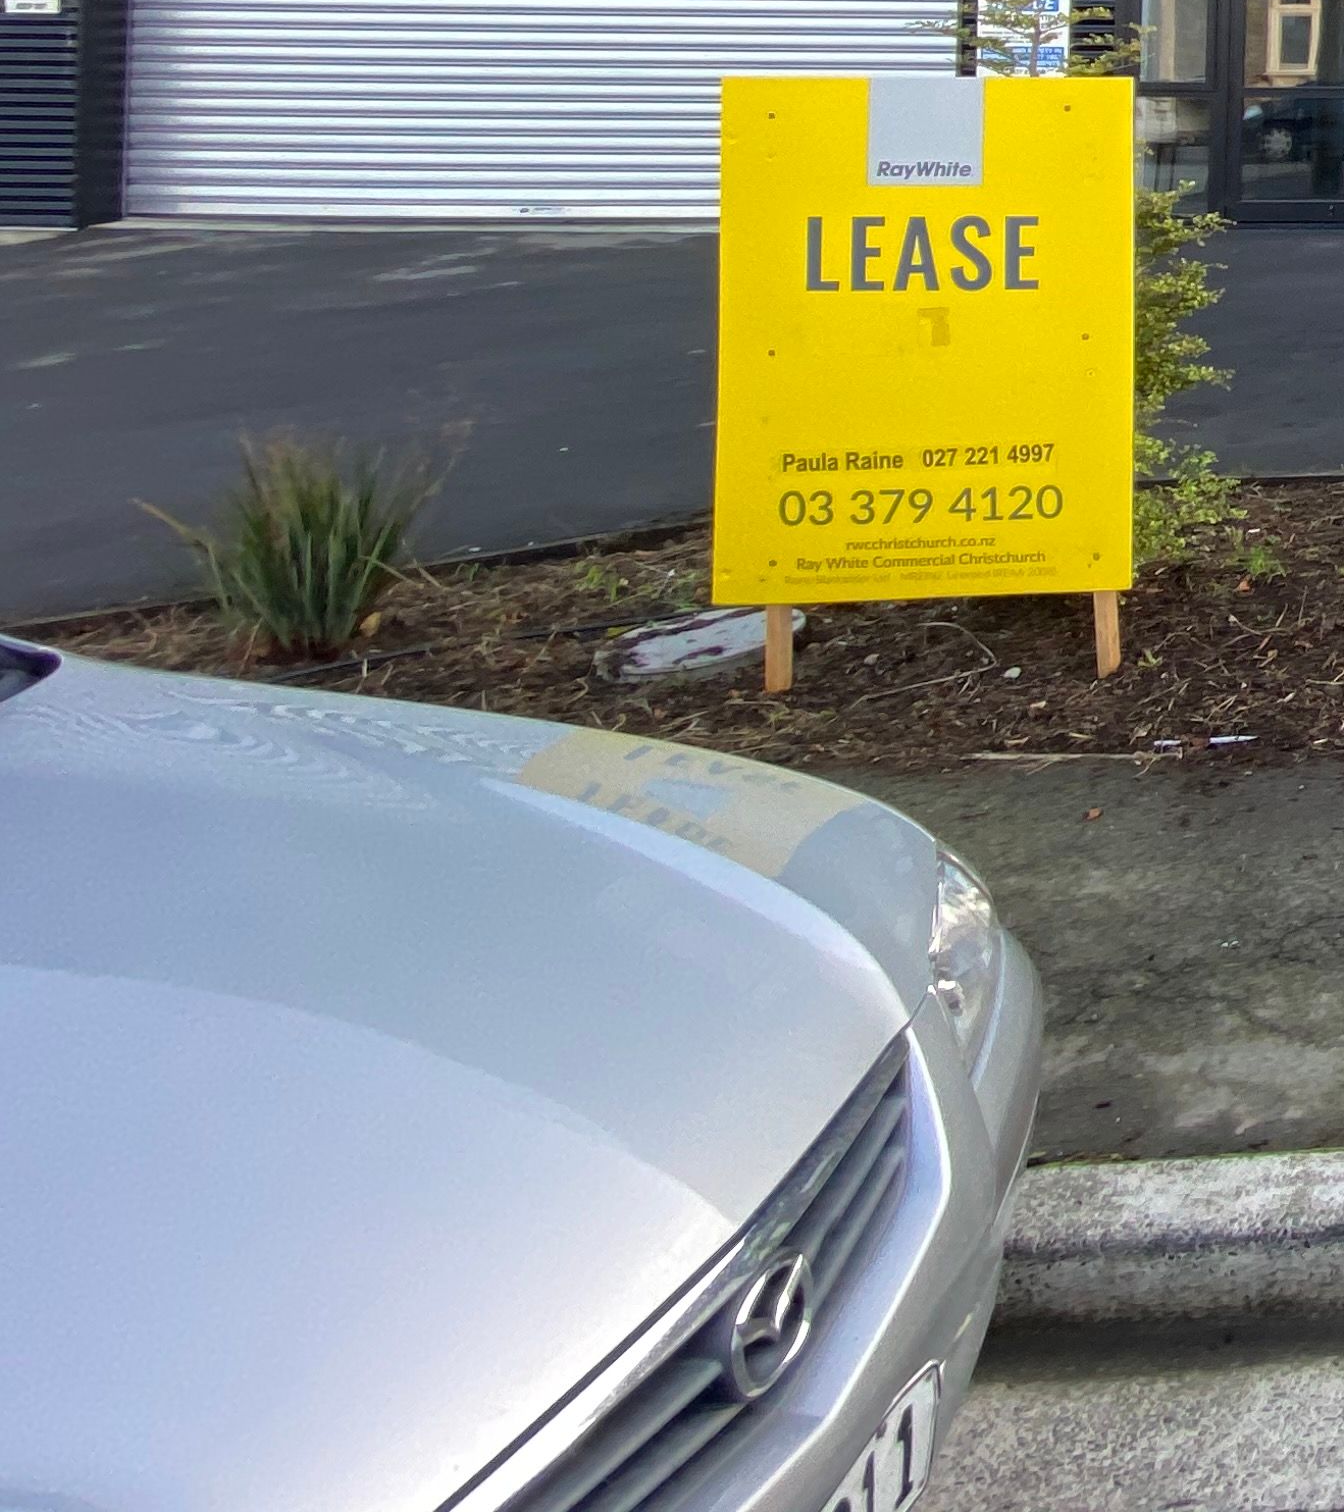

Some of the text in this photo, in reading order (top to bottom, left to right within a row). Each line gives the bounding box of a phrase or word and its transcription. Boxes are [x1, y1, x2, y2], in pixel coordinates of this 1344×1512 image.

[805, 215, 1040, 292] LEASE
[782, 443, 1055, 472] Paula Raine 027 221 4997
[778, 484, 1064, 526] 03 379 4120
[845, 536, 996, 551] rwcchristchurch.co.nz
[796, 551, 1046, 572] Ray White Commercial Christchurch
